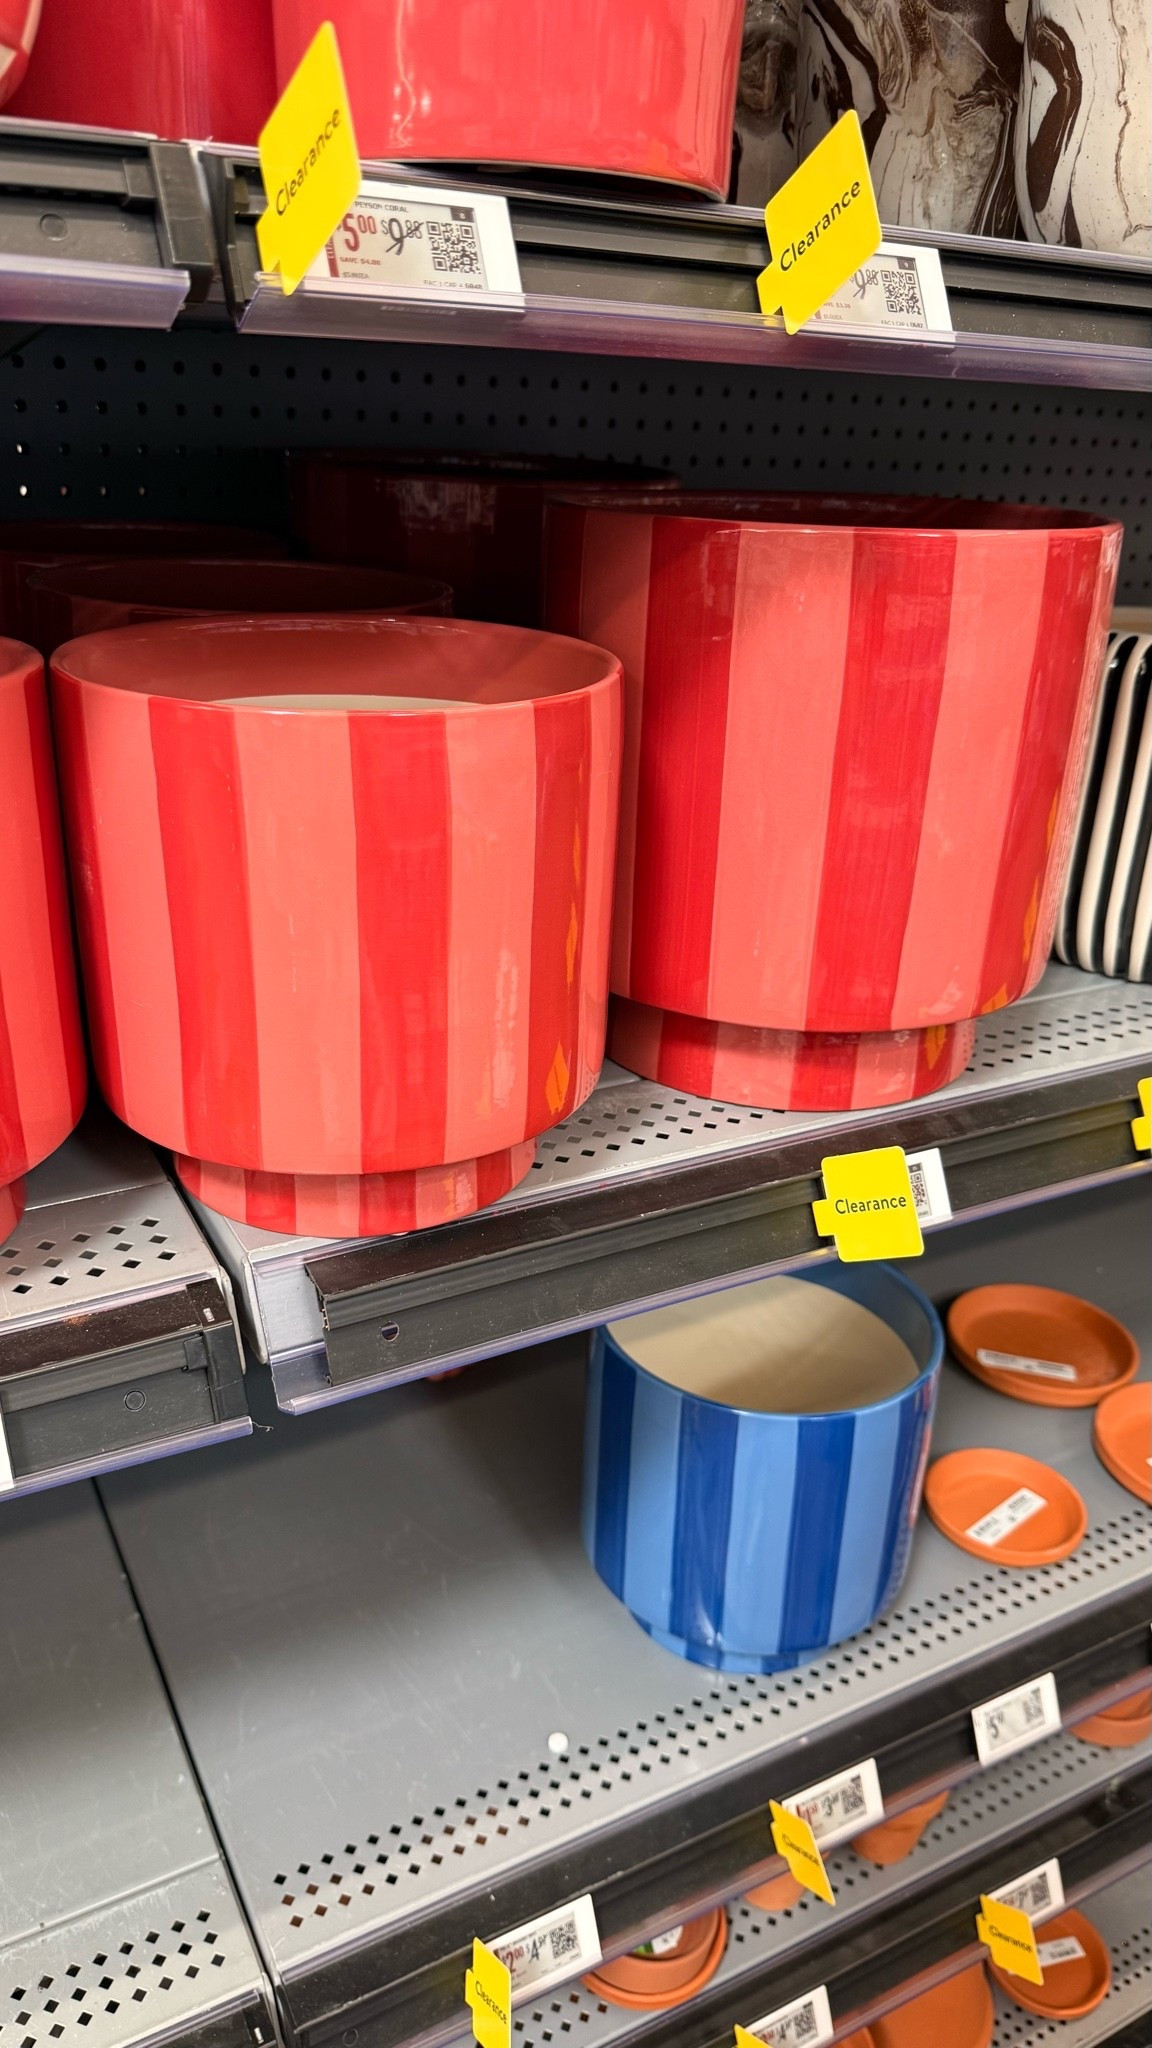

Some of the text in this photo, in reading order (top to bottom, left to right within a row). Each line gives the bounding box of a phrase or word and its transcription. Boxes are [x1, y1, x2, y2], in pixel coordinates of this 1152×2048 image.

[276, 109, 340, 216] Clearance
[354, 201, 382, 210] PEYSON
[780, 181, 861, 272] Clearance
[835, 1196, 907, 1214] Clearance
[988, 1924, 1033, 1953] Clearance
[475, 1980, 508, 2025] Clearance
